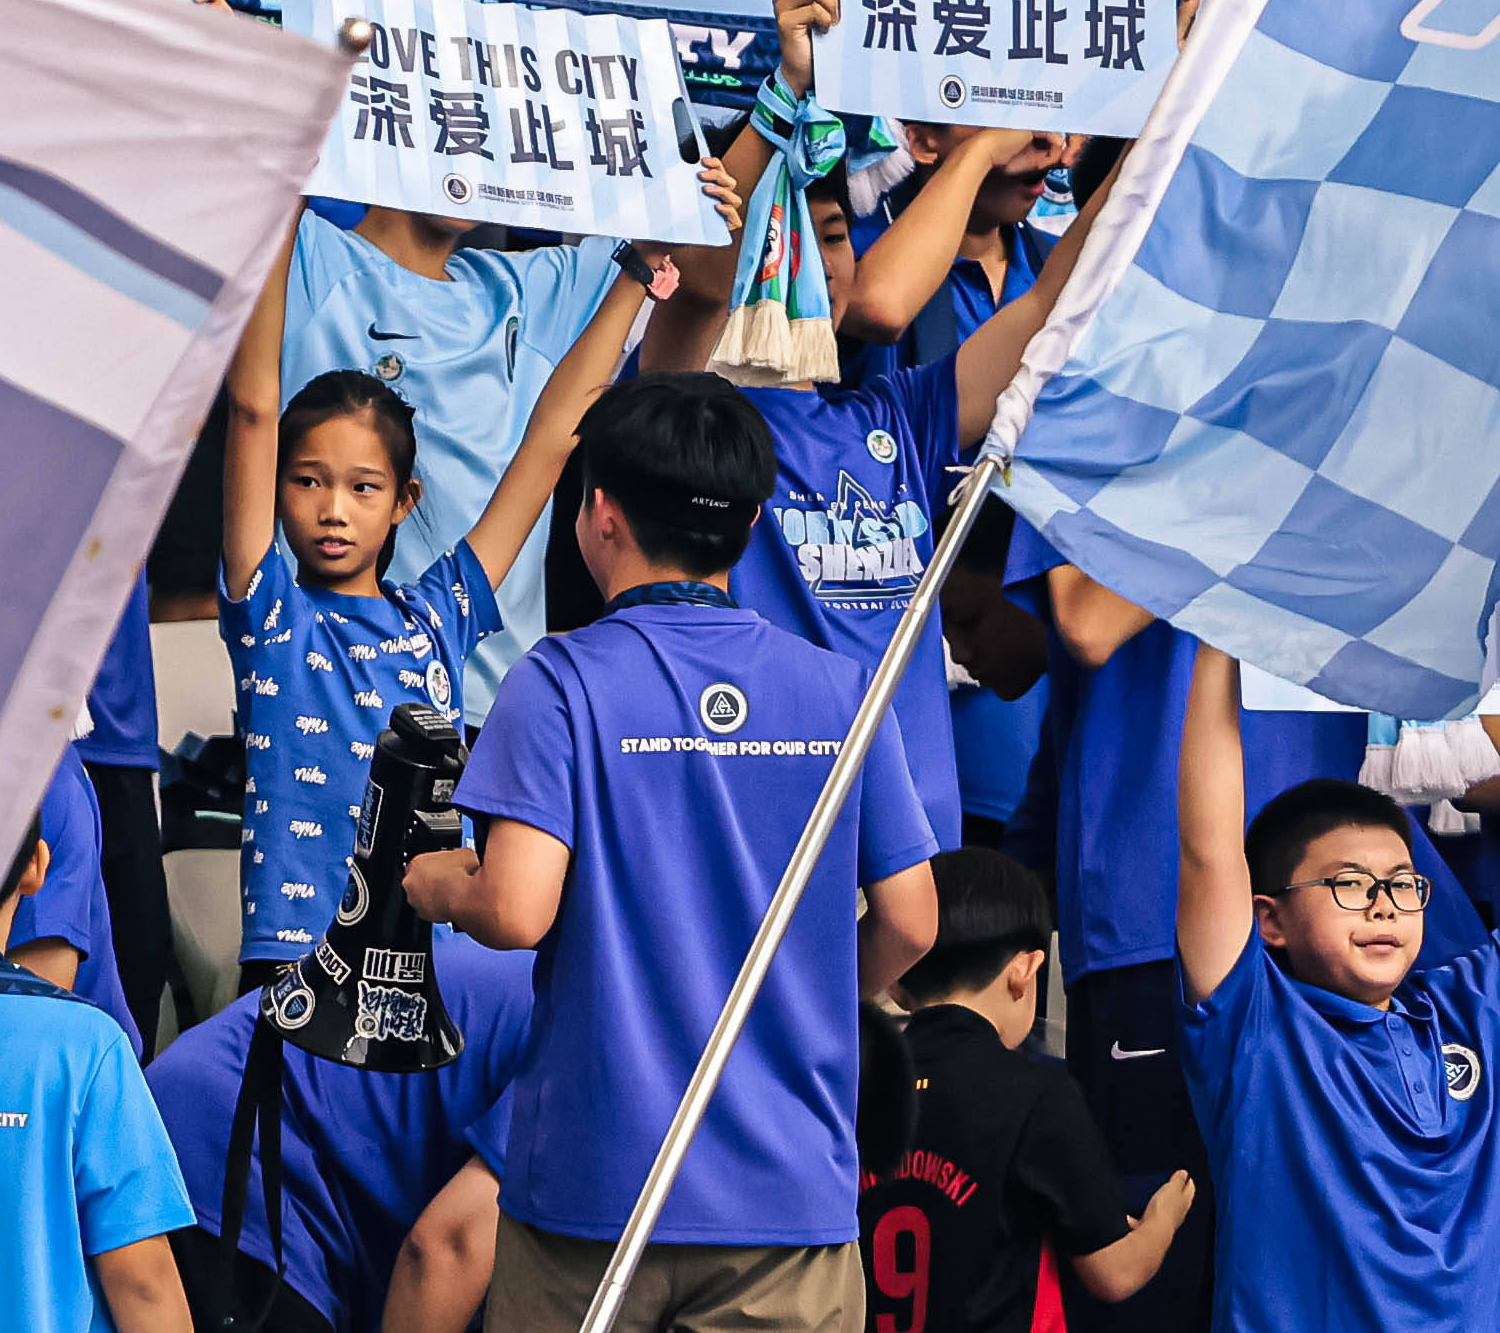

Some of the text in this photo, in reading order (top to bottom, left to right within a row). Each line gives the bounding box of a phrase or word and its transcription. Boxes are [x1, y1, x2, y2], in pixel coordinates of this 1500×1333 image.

[369, 21, 638, 101] OVE THIS CITY
[971, 85, 1063, 103] 深圳新鹏城足球俱乐部
[350, 74, 653, 178] 深爱此城
[478, 183, 573, 206] 深圳新鹏城足球俱乐部
[354, 689, 384, 710] nike
[620, 737, 842, 756] STAND TOGHER FOR OUR CITY
[294, 765, 328, 786] nike
[873, 1205, 931, 1333] 9
